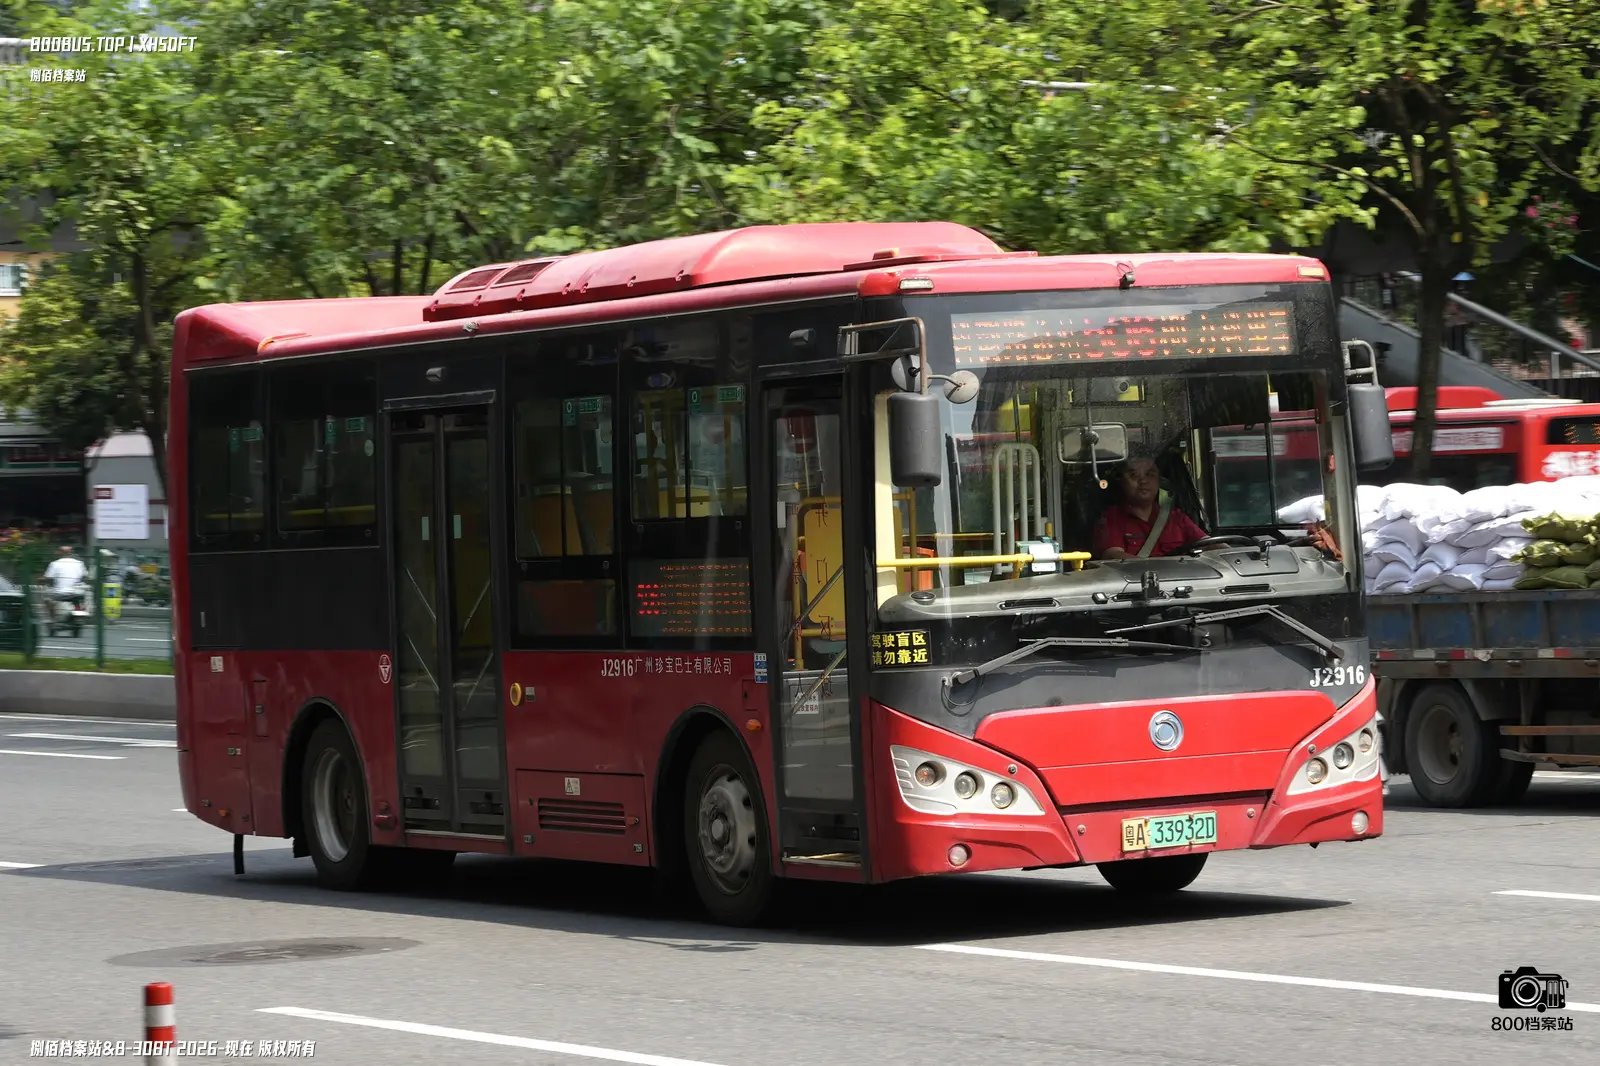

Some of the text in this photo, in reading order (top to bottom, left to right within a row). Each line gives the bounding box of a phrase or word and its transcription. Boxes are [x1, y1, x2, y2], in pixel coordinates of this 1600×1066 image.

[871, 631, 927, 649] 驾驶盲区
[601, 658, 634, 677] J2916
[635, 656, 732, 676] 广州珍宝巴士有限公司
[872, 648, 929, 665] 请勿靠近
[1309, 664, 1365, 688] J2916
[1154, 816, 1215, 844] 33932D
